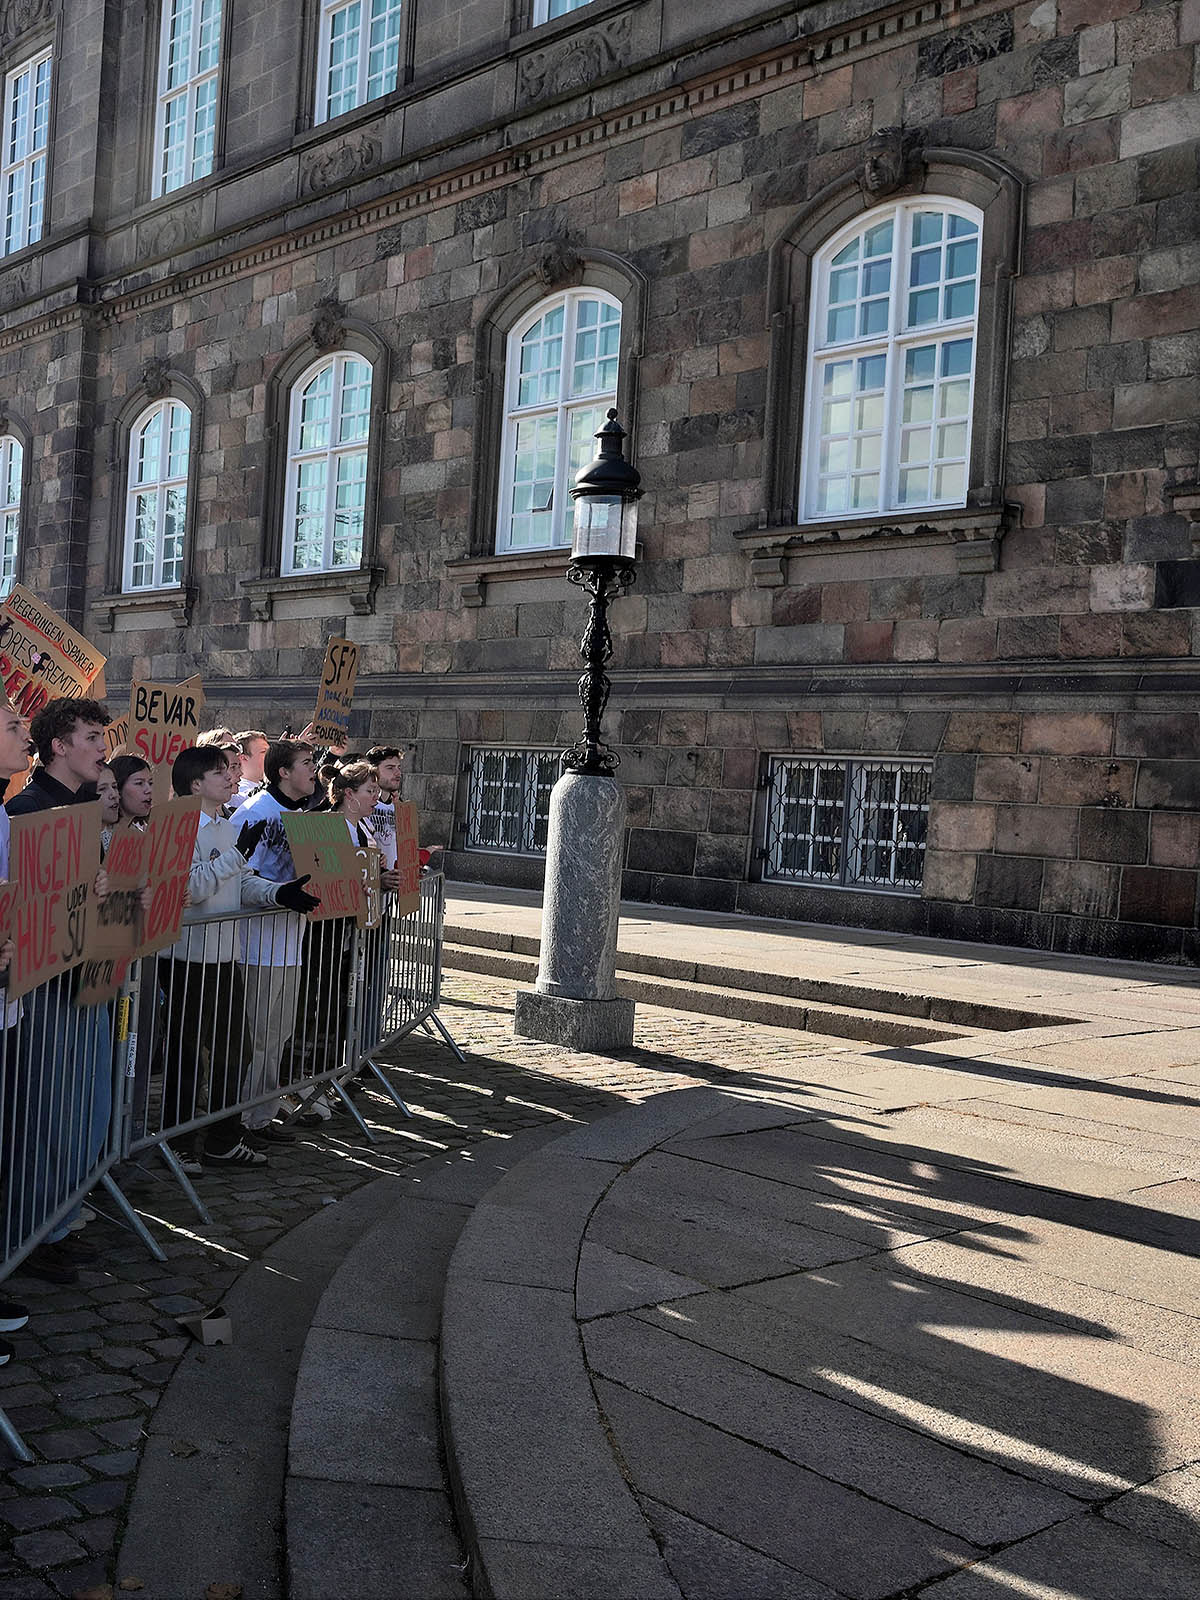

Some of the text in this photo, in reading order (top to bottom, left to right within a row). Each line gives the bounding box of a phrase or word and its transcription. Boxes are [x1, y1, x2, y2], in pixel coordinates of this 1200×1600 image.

[8, 594, 95, 677] REGERINGEN SPARER
[32, 652, 83, 700] FREMTID
[325, 645, 356, 685] SF?
[135, 686, 197, 727] BEVAR
[18, 813, 83, 901] INGEN
[149, 814, 175, 878] VI
[66, 883, 89, 911] UDEN
[17, 894, 62, 980] HUE
[62, 908, 87, 962] SU
